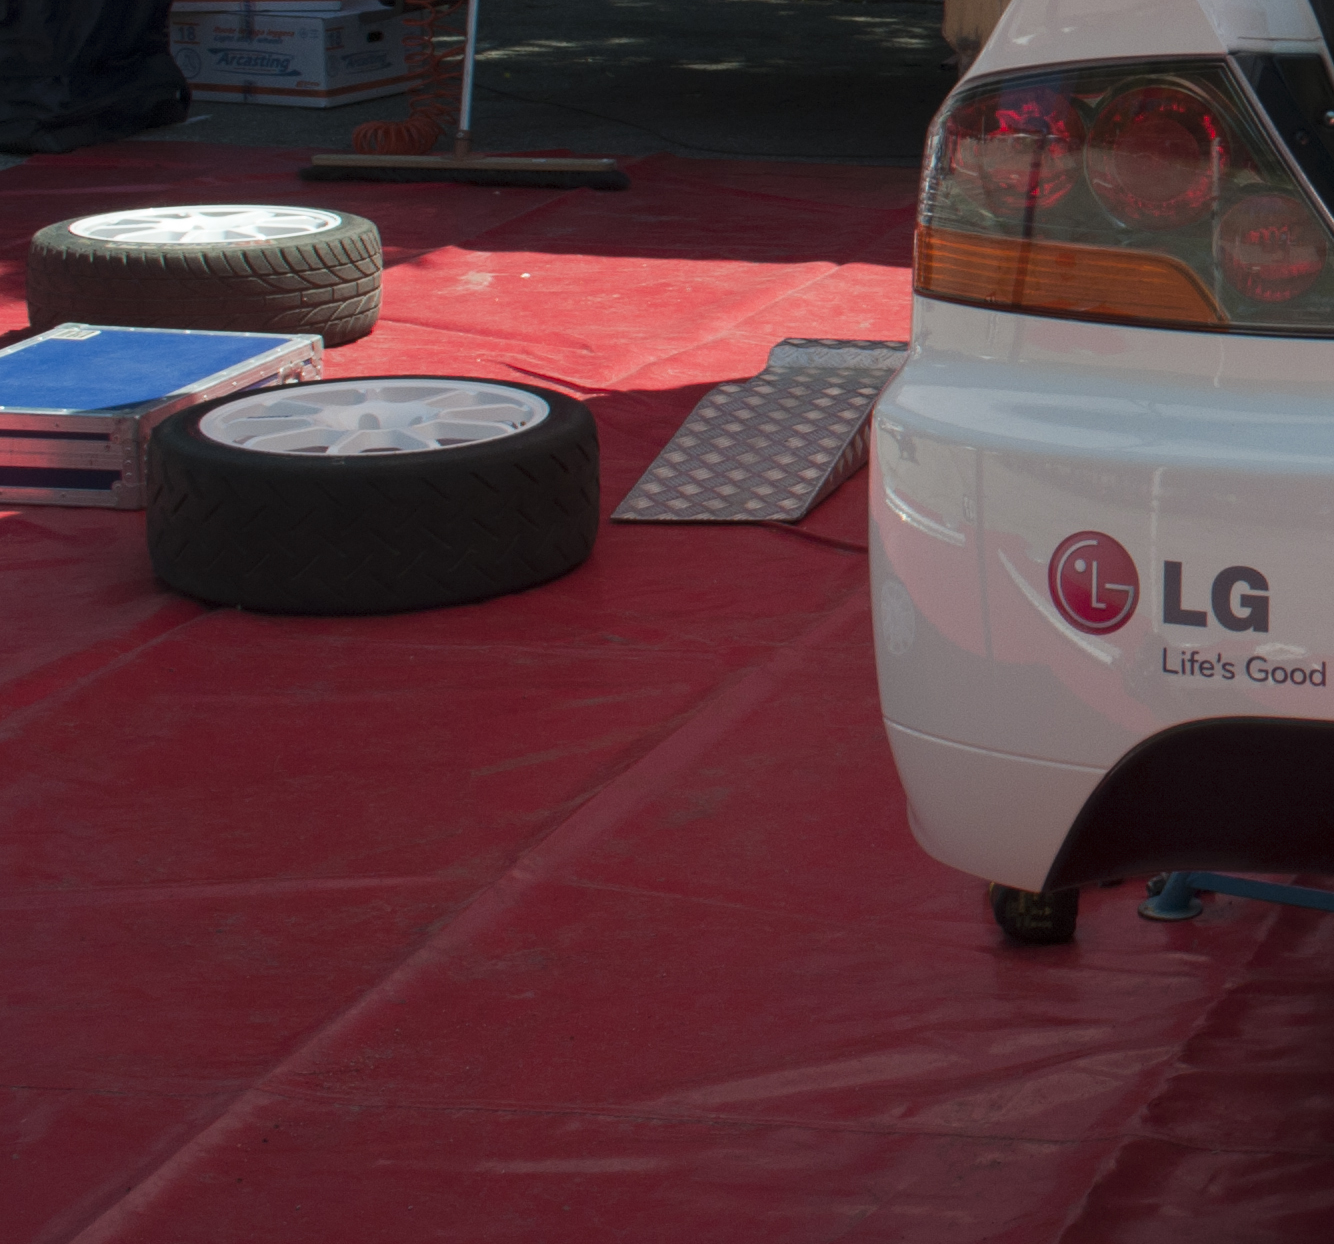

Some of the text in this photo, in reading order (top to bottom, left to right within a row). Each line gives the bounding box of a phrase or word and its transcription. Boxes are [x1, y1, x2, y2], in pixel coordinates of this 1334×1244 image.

[178, 26, 196, 42] 18
[216, 51, 291, 73] Arcasting
[1163, 560, 1270, 633] LG
[1162, 647, 1328, 687] Life's Good
